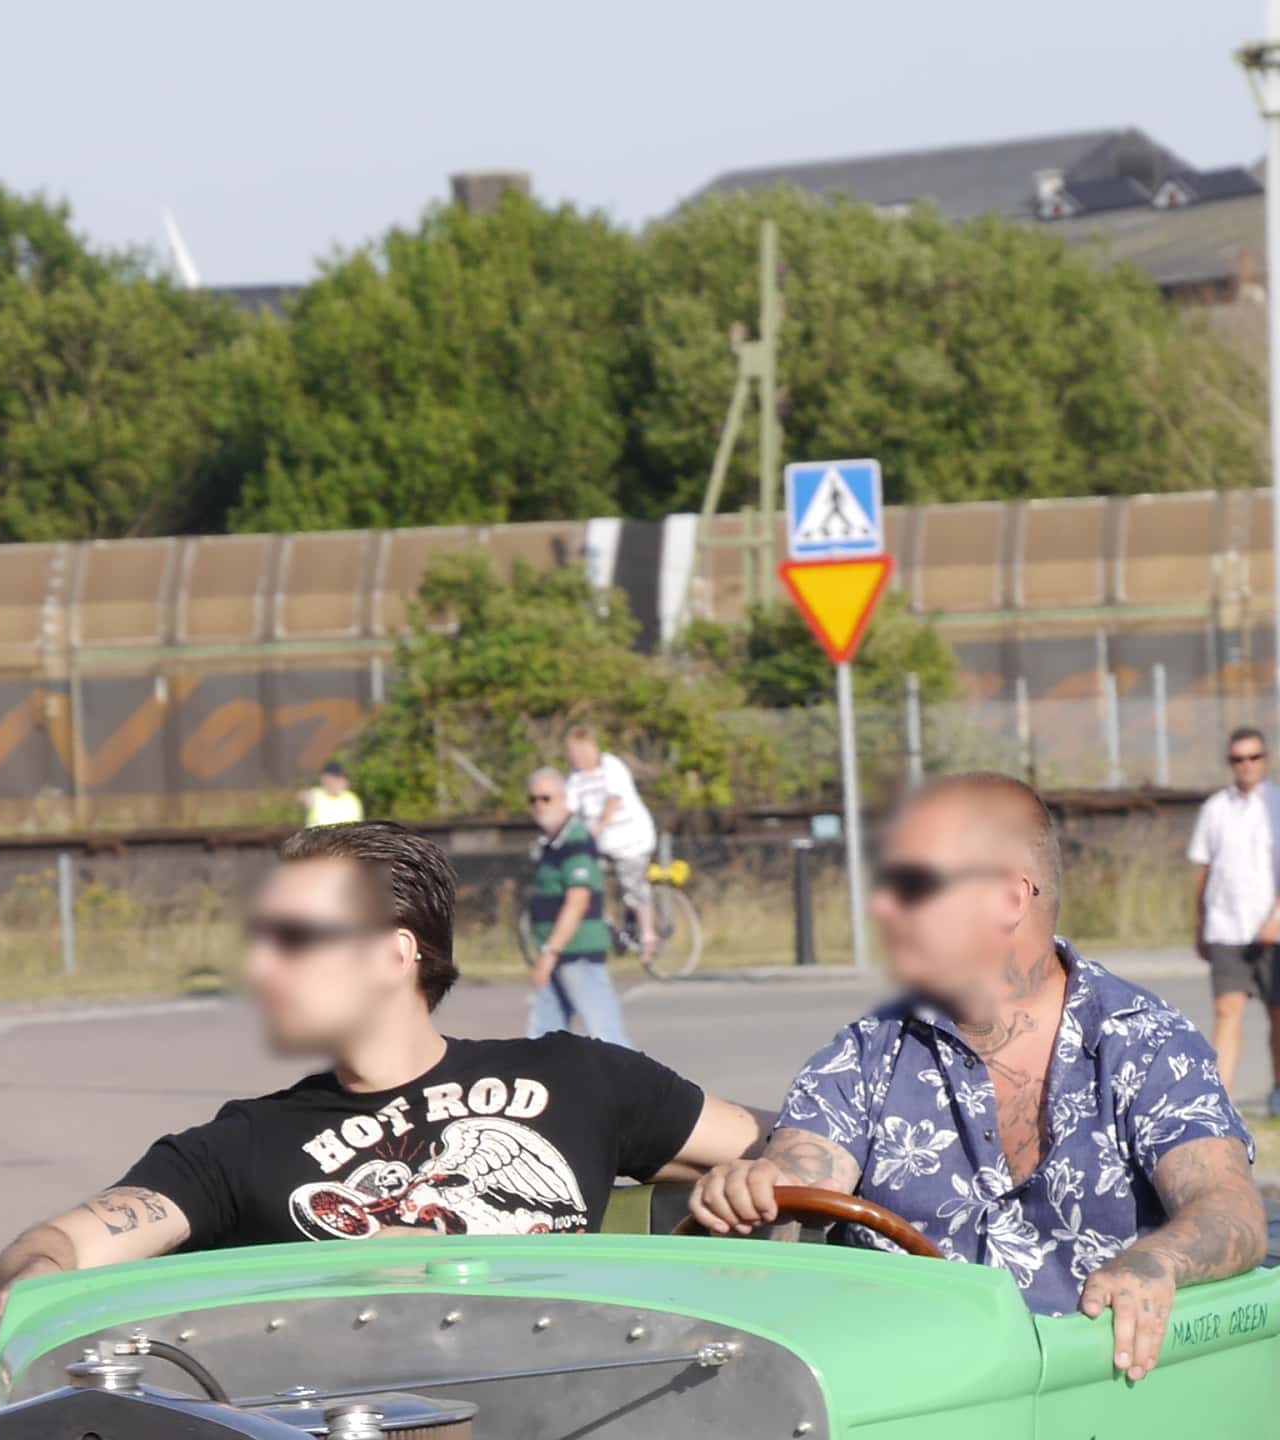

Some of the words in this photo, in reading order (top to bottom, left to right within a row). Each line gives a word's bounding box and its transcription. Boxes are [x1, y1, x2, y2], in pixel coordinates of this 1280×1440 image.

[302, 1096, 415, 1174] HOT
[422, 1077, 549, 1123] ROD
[554, 1214, 588, 1230] 100%
[1171, 1312, 1221, 1350] MASTER
[1229, 1303, 1269, 1336] GREEN
